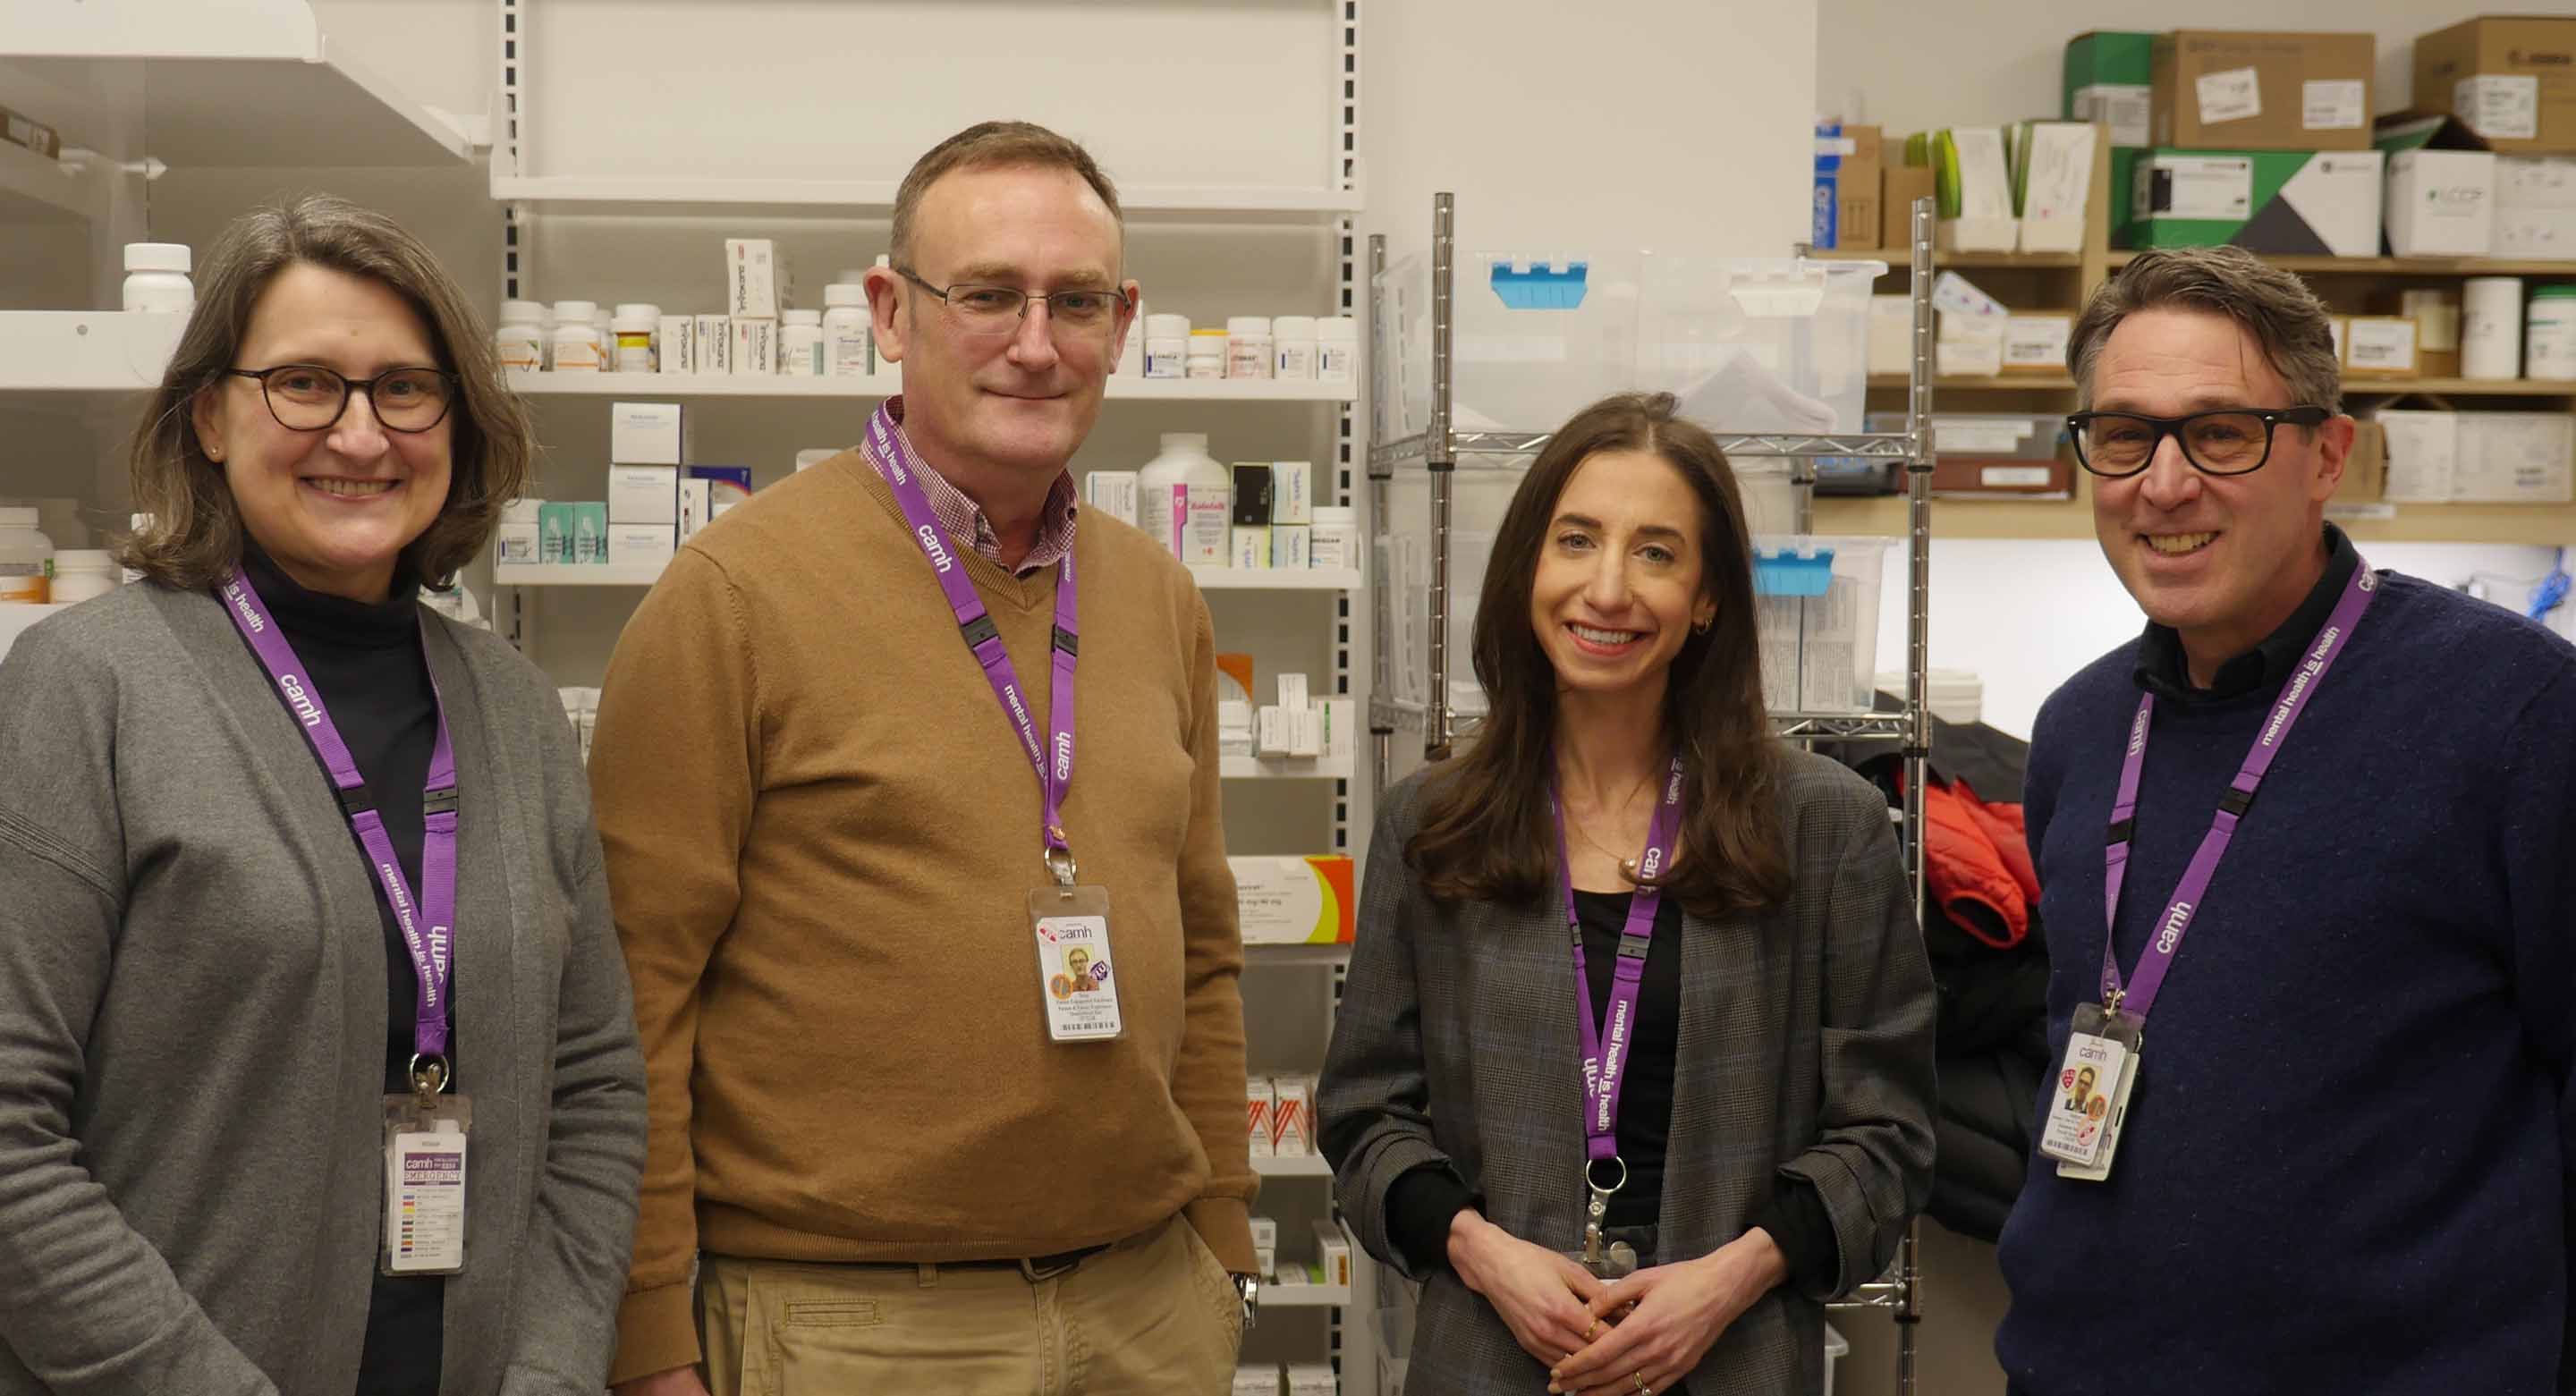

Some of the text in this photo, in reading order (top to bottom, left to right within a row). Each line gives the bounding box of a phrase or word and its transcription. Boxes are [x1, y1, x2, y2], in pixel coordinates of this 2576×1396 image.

[877, 439, 892, 458] is
[886, 451, 907, 486] health
[919, 524, 953, 572] camh
[234, 594, 266, 633] health
[280, 674, 322, 727] camh
[2262, 626, 2341, 746] mental health is health
[1004, 684, 1030, 725] mental
[1023, 721, 1041, 763] health
[1057, 732, 1072, 781] camh
[382, 864, 409, 908] mental
[401, 910, 423, 949] health
[422, 965, 436, 1008] health
[2157, 901, 2191, 954] camh
[1597, 1000, 1628, 1131] mental health is health
[406, 1157, 433, 1169] camh
